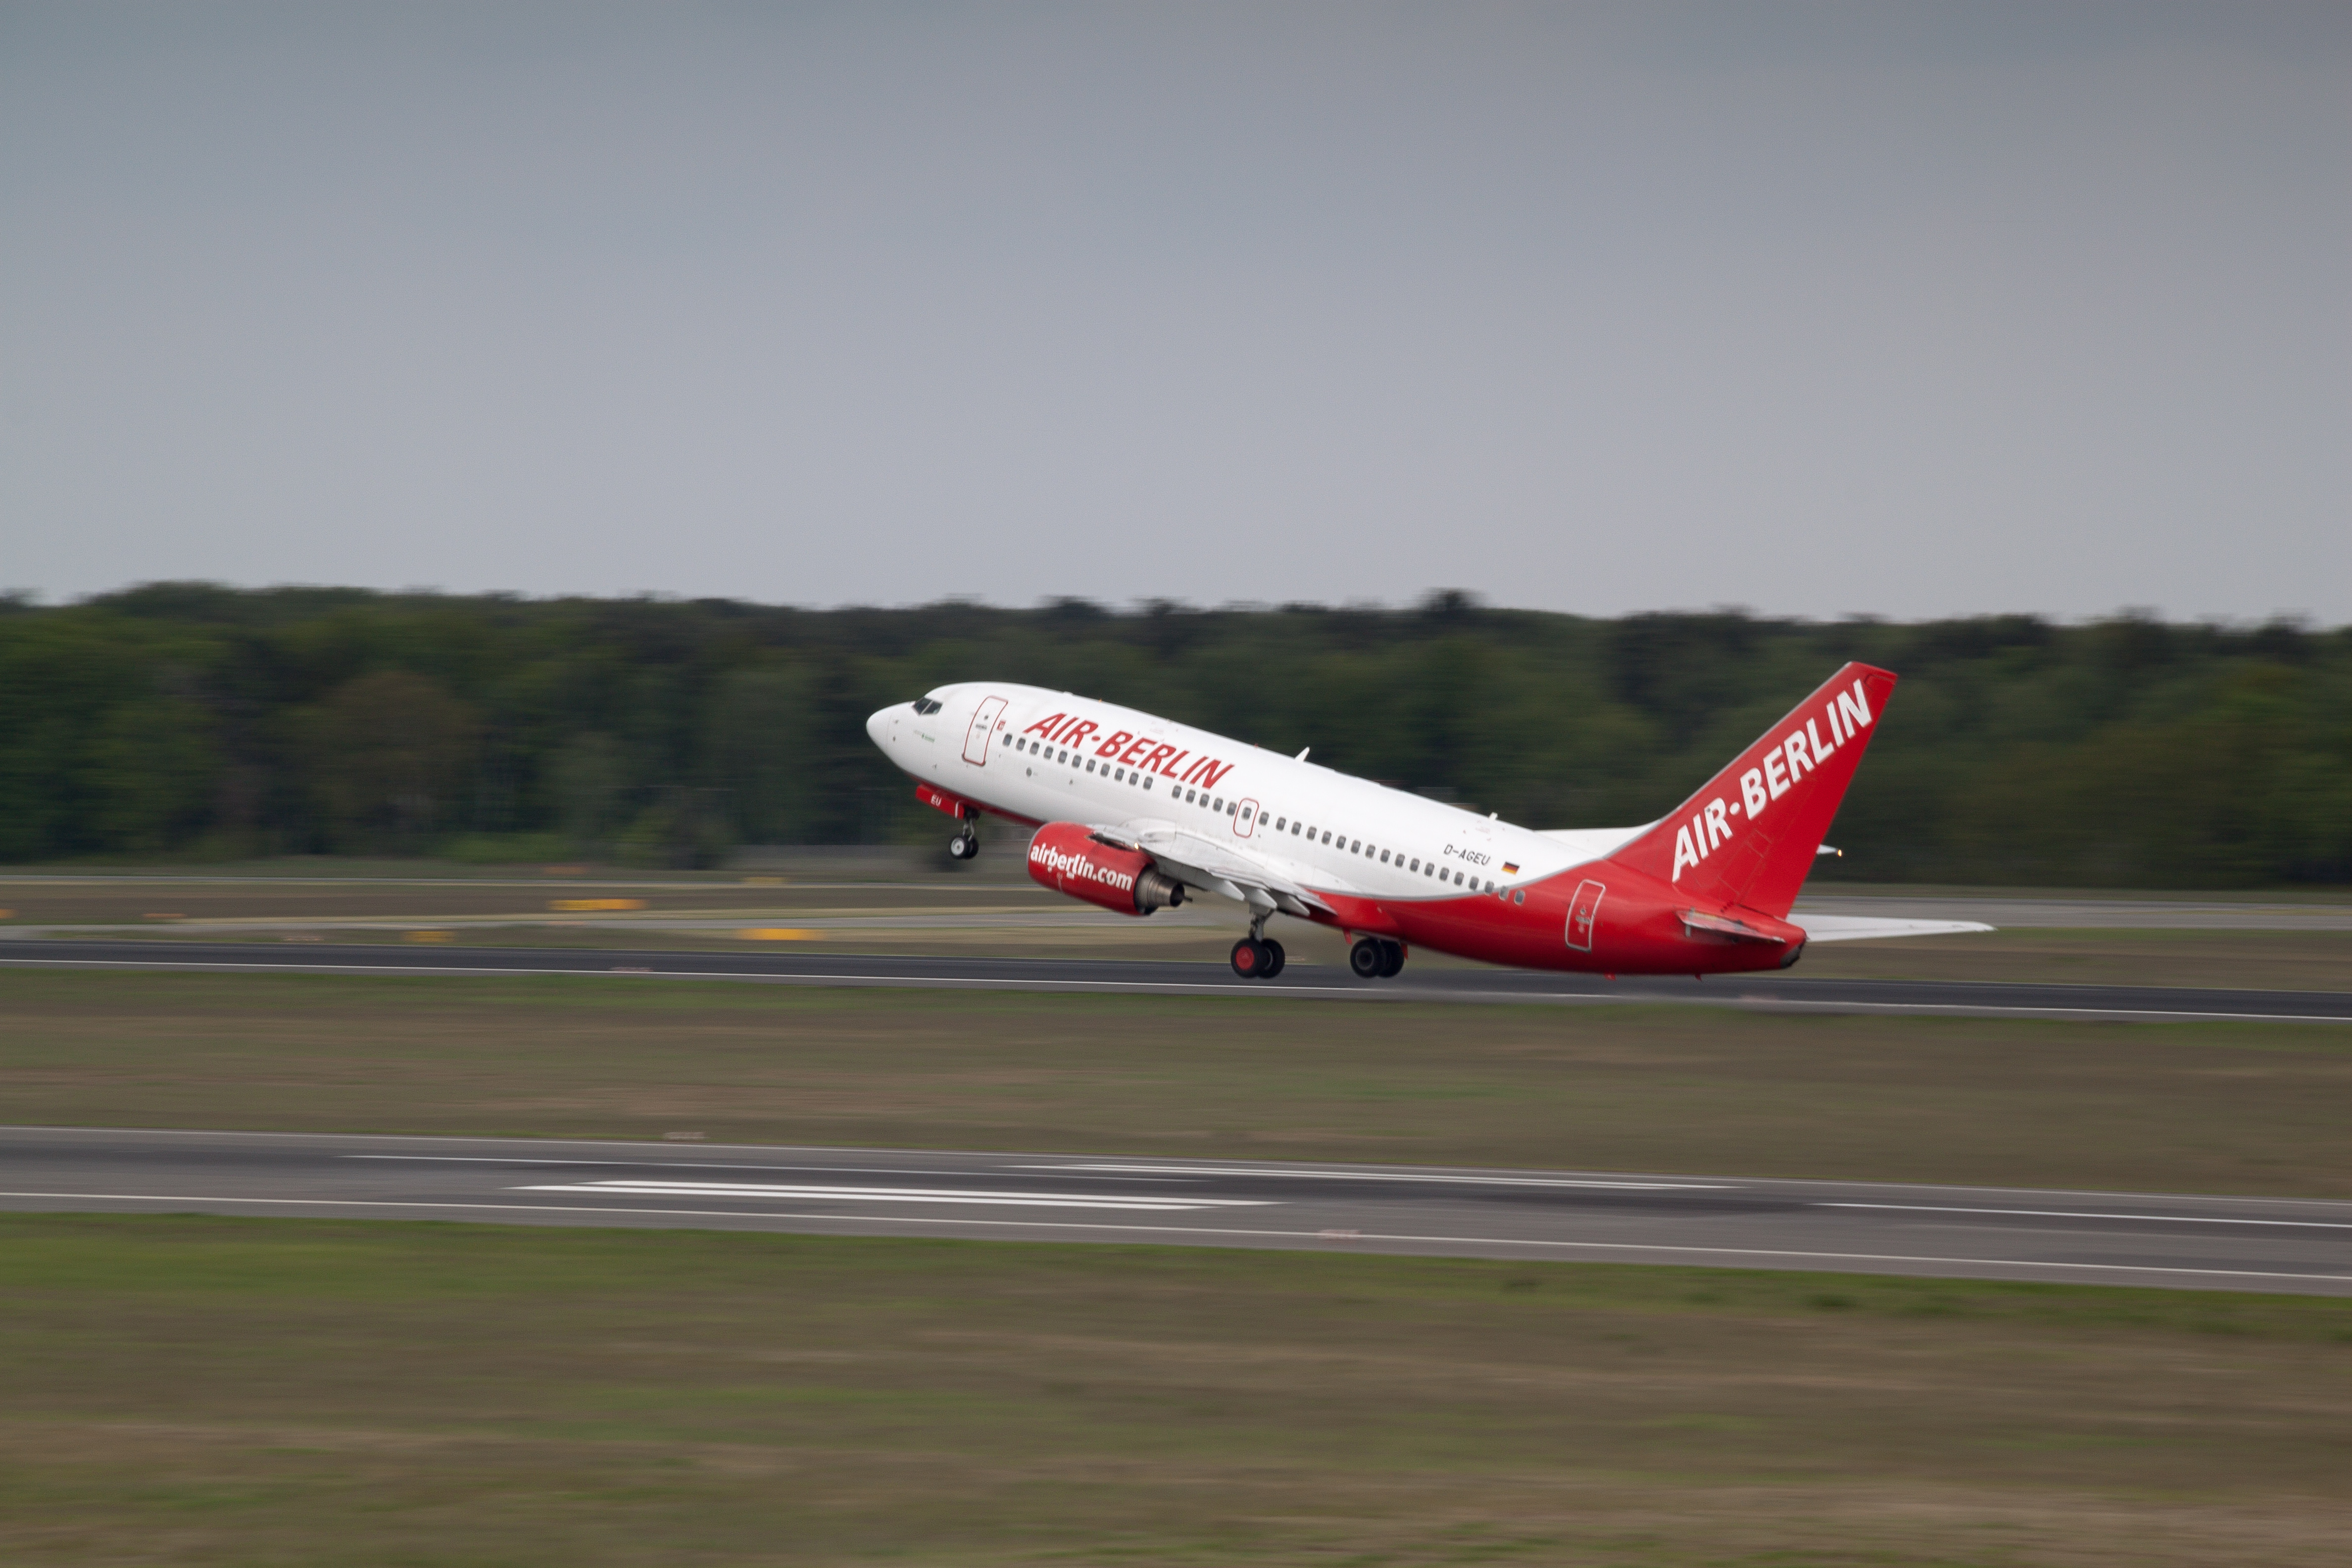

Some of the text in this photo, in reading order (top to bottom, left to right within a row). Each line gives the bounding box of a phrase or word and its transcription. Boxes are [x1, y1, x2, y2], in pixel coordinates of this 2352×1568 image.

[931, 794, 942, 807] EU
[1444, 844, 1490, 866] D-AGEU
[1030, 842, 1132, 891] airberlin.com
